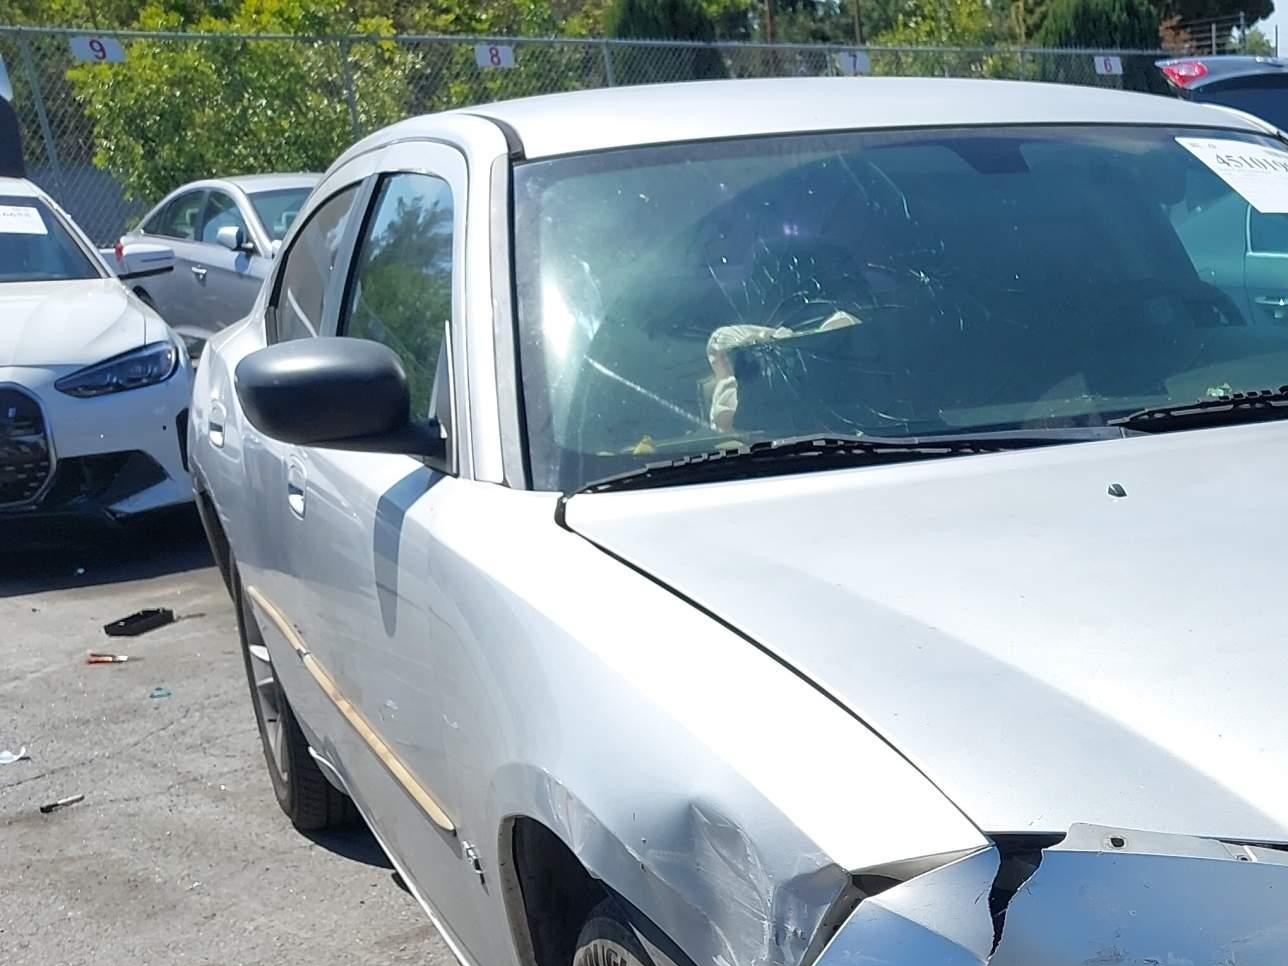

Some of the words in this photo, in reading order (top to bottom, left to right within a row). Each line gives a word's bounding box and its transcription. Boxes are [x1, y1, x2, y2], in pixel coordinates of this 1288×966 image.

[89, 39, 106, 60] 9
[489, 46, 501, 66] 8
[1103, 58, 1113, 73] 6
